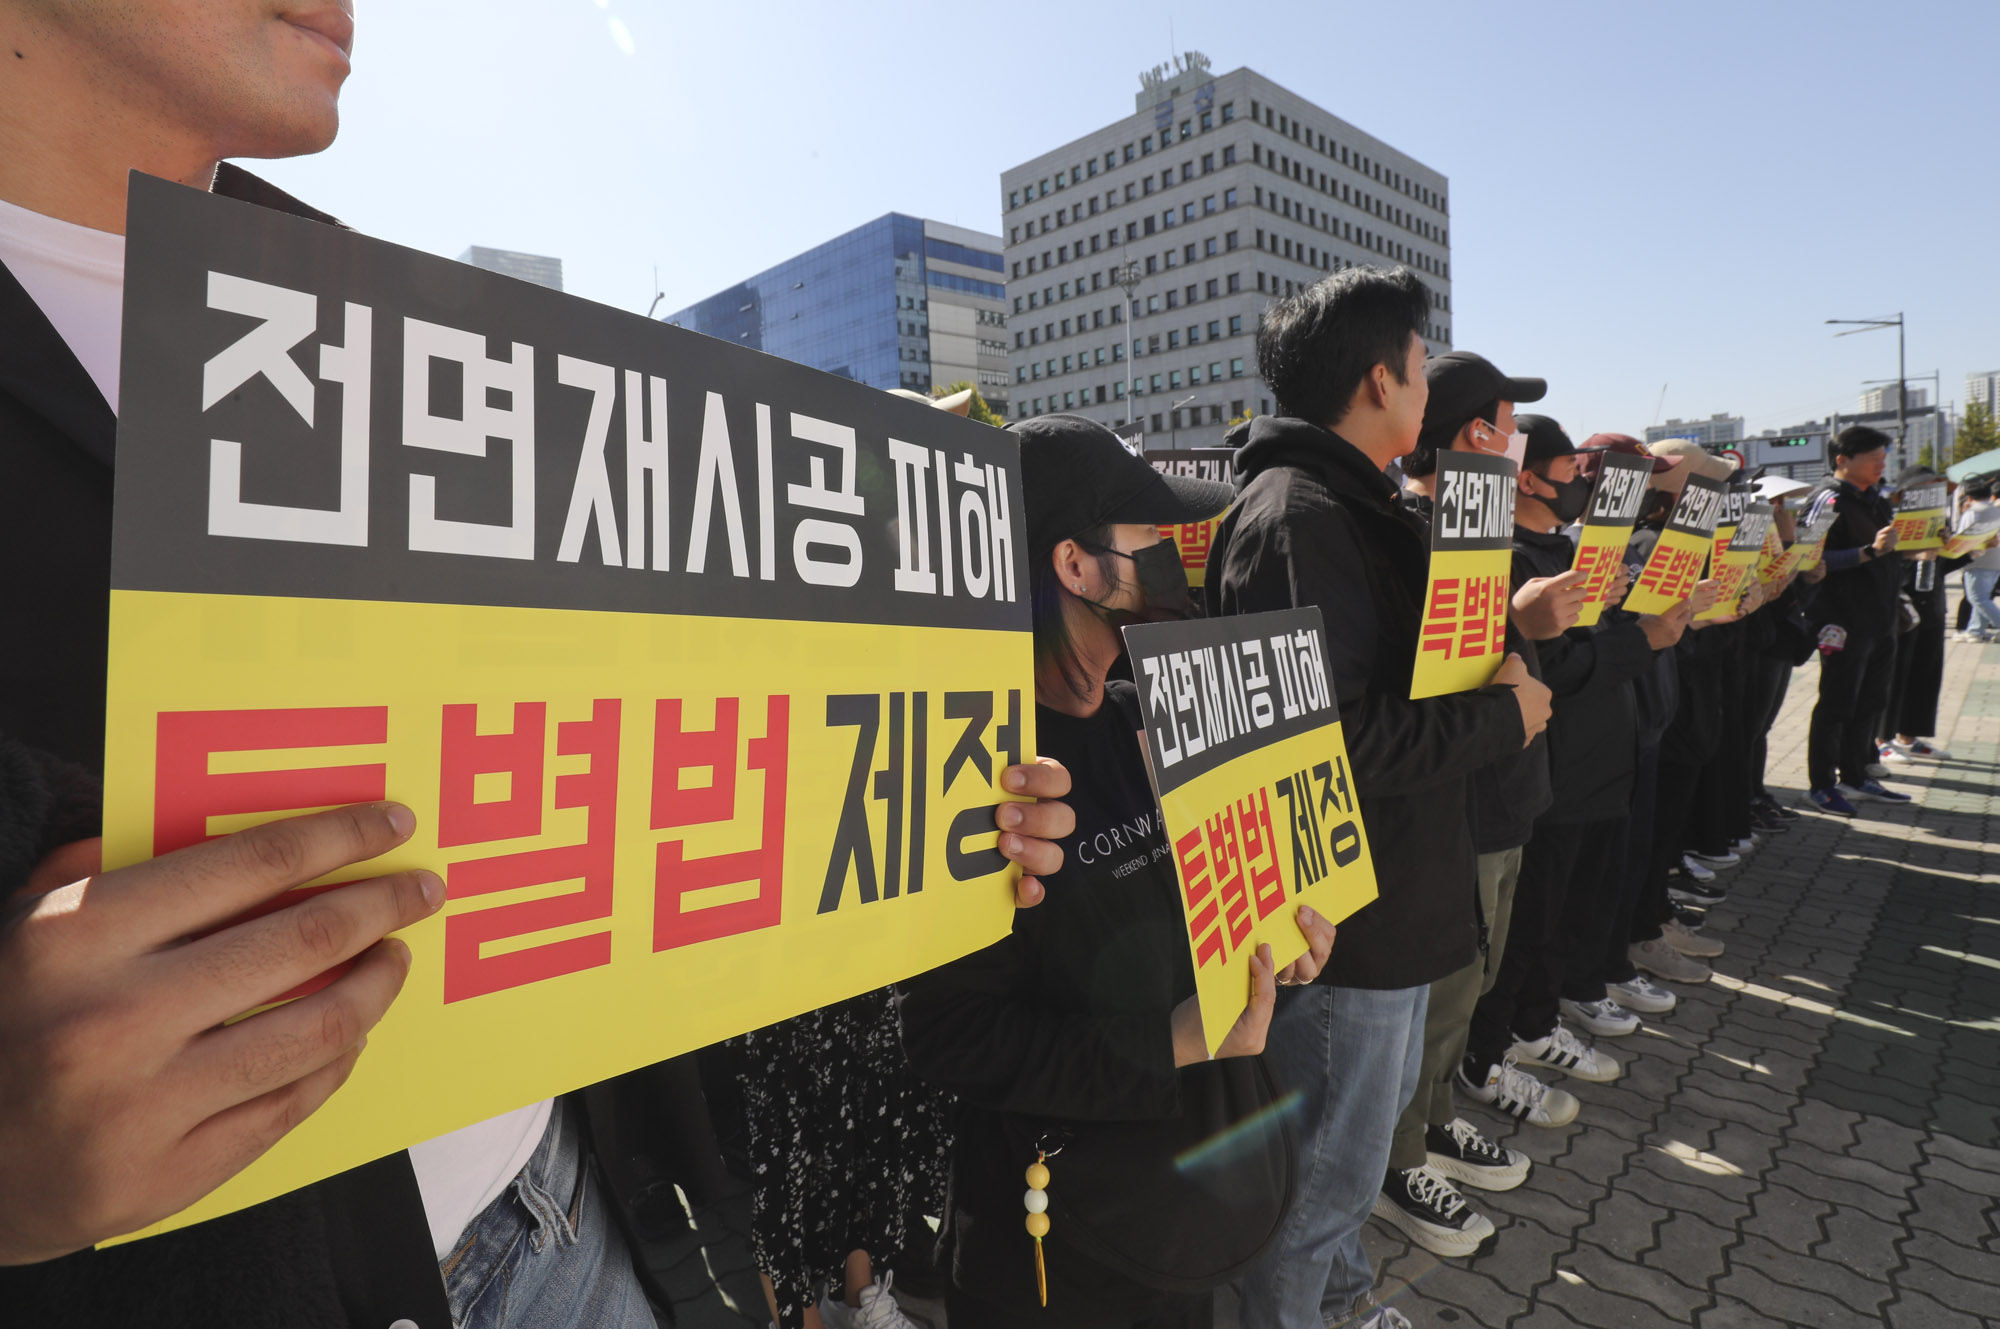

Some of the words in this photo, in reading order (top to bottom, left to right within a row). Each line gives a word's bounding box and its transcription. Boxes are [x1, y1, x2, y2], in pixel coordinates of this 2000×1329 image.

[202, 270, 865, 588] 전면재시공
[888, 438, 1017, 602] 피해
[1142, 639, 1275, 768] 전면재시공
[1271, 629, 1331, 720] 피해
[1422, 575, 1509, 660] 특별법
[817, 689, 1021, 915] 제정
[1111, 854, 1149, 880] WEEKEND
[1175, 787, 1286, 970] 특별법
[1275, 755, 1361, 895] 제정
